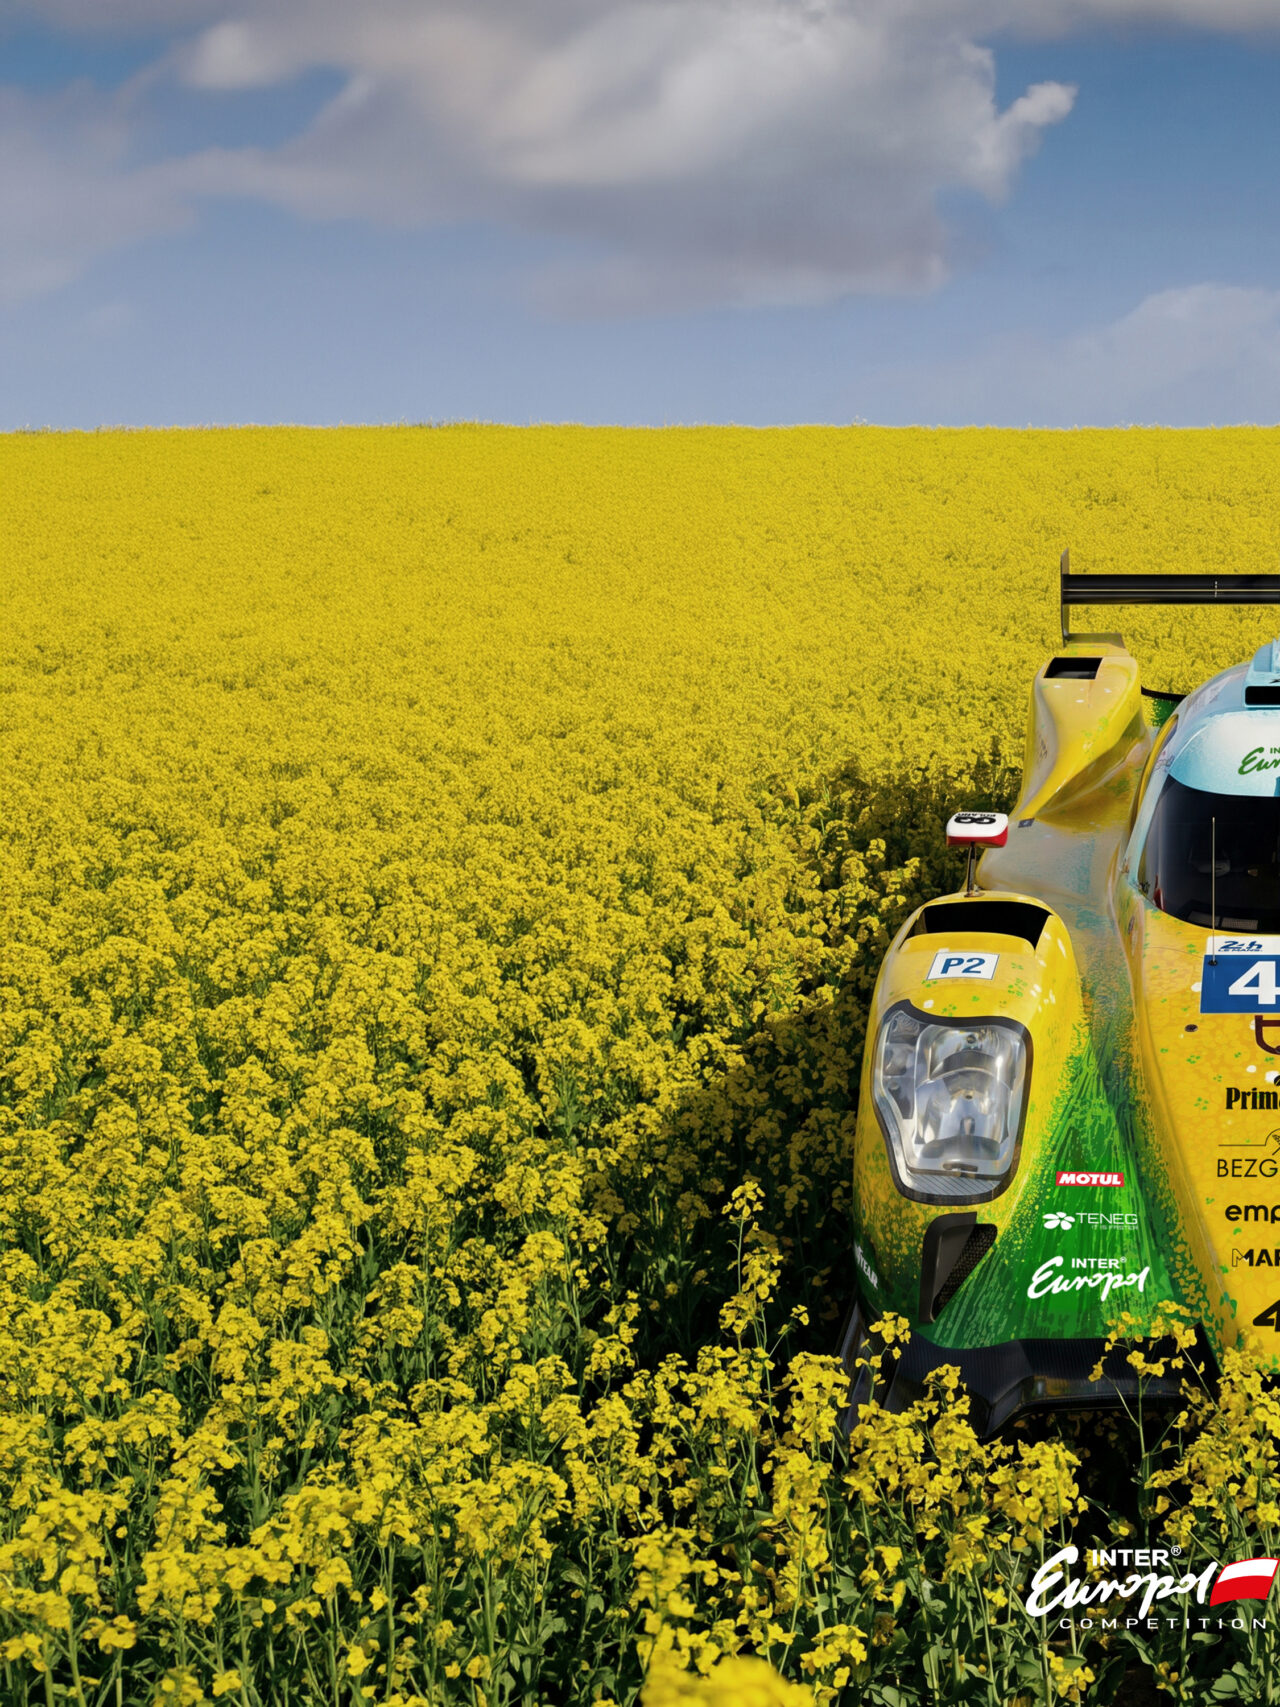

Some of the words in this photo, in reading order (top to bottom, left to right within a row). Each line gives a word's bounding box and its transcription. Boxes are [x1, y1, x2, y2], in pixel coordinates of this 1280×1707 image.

[940, 957, 985, 974] P2
[1058, 1173, 1122, 1185] MOTUL
[1075, 1212, 1138, 1225] TENEG
[1027, 1255, 1150, 1302] Europol
